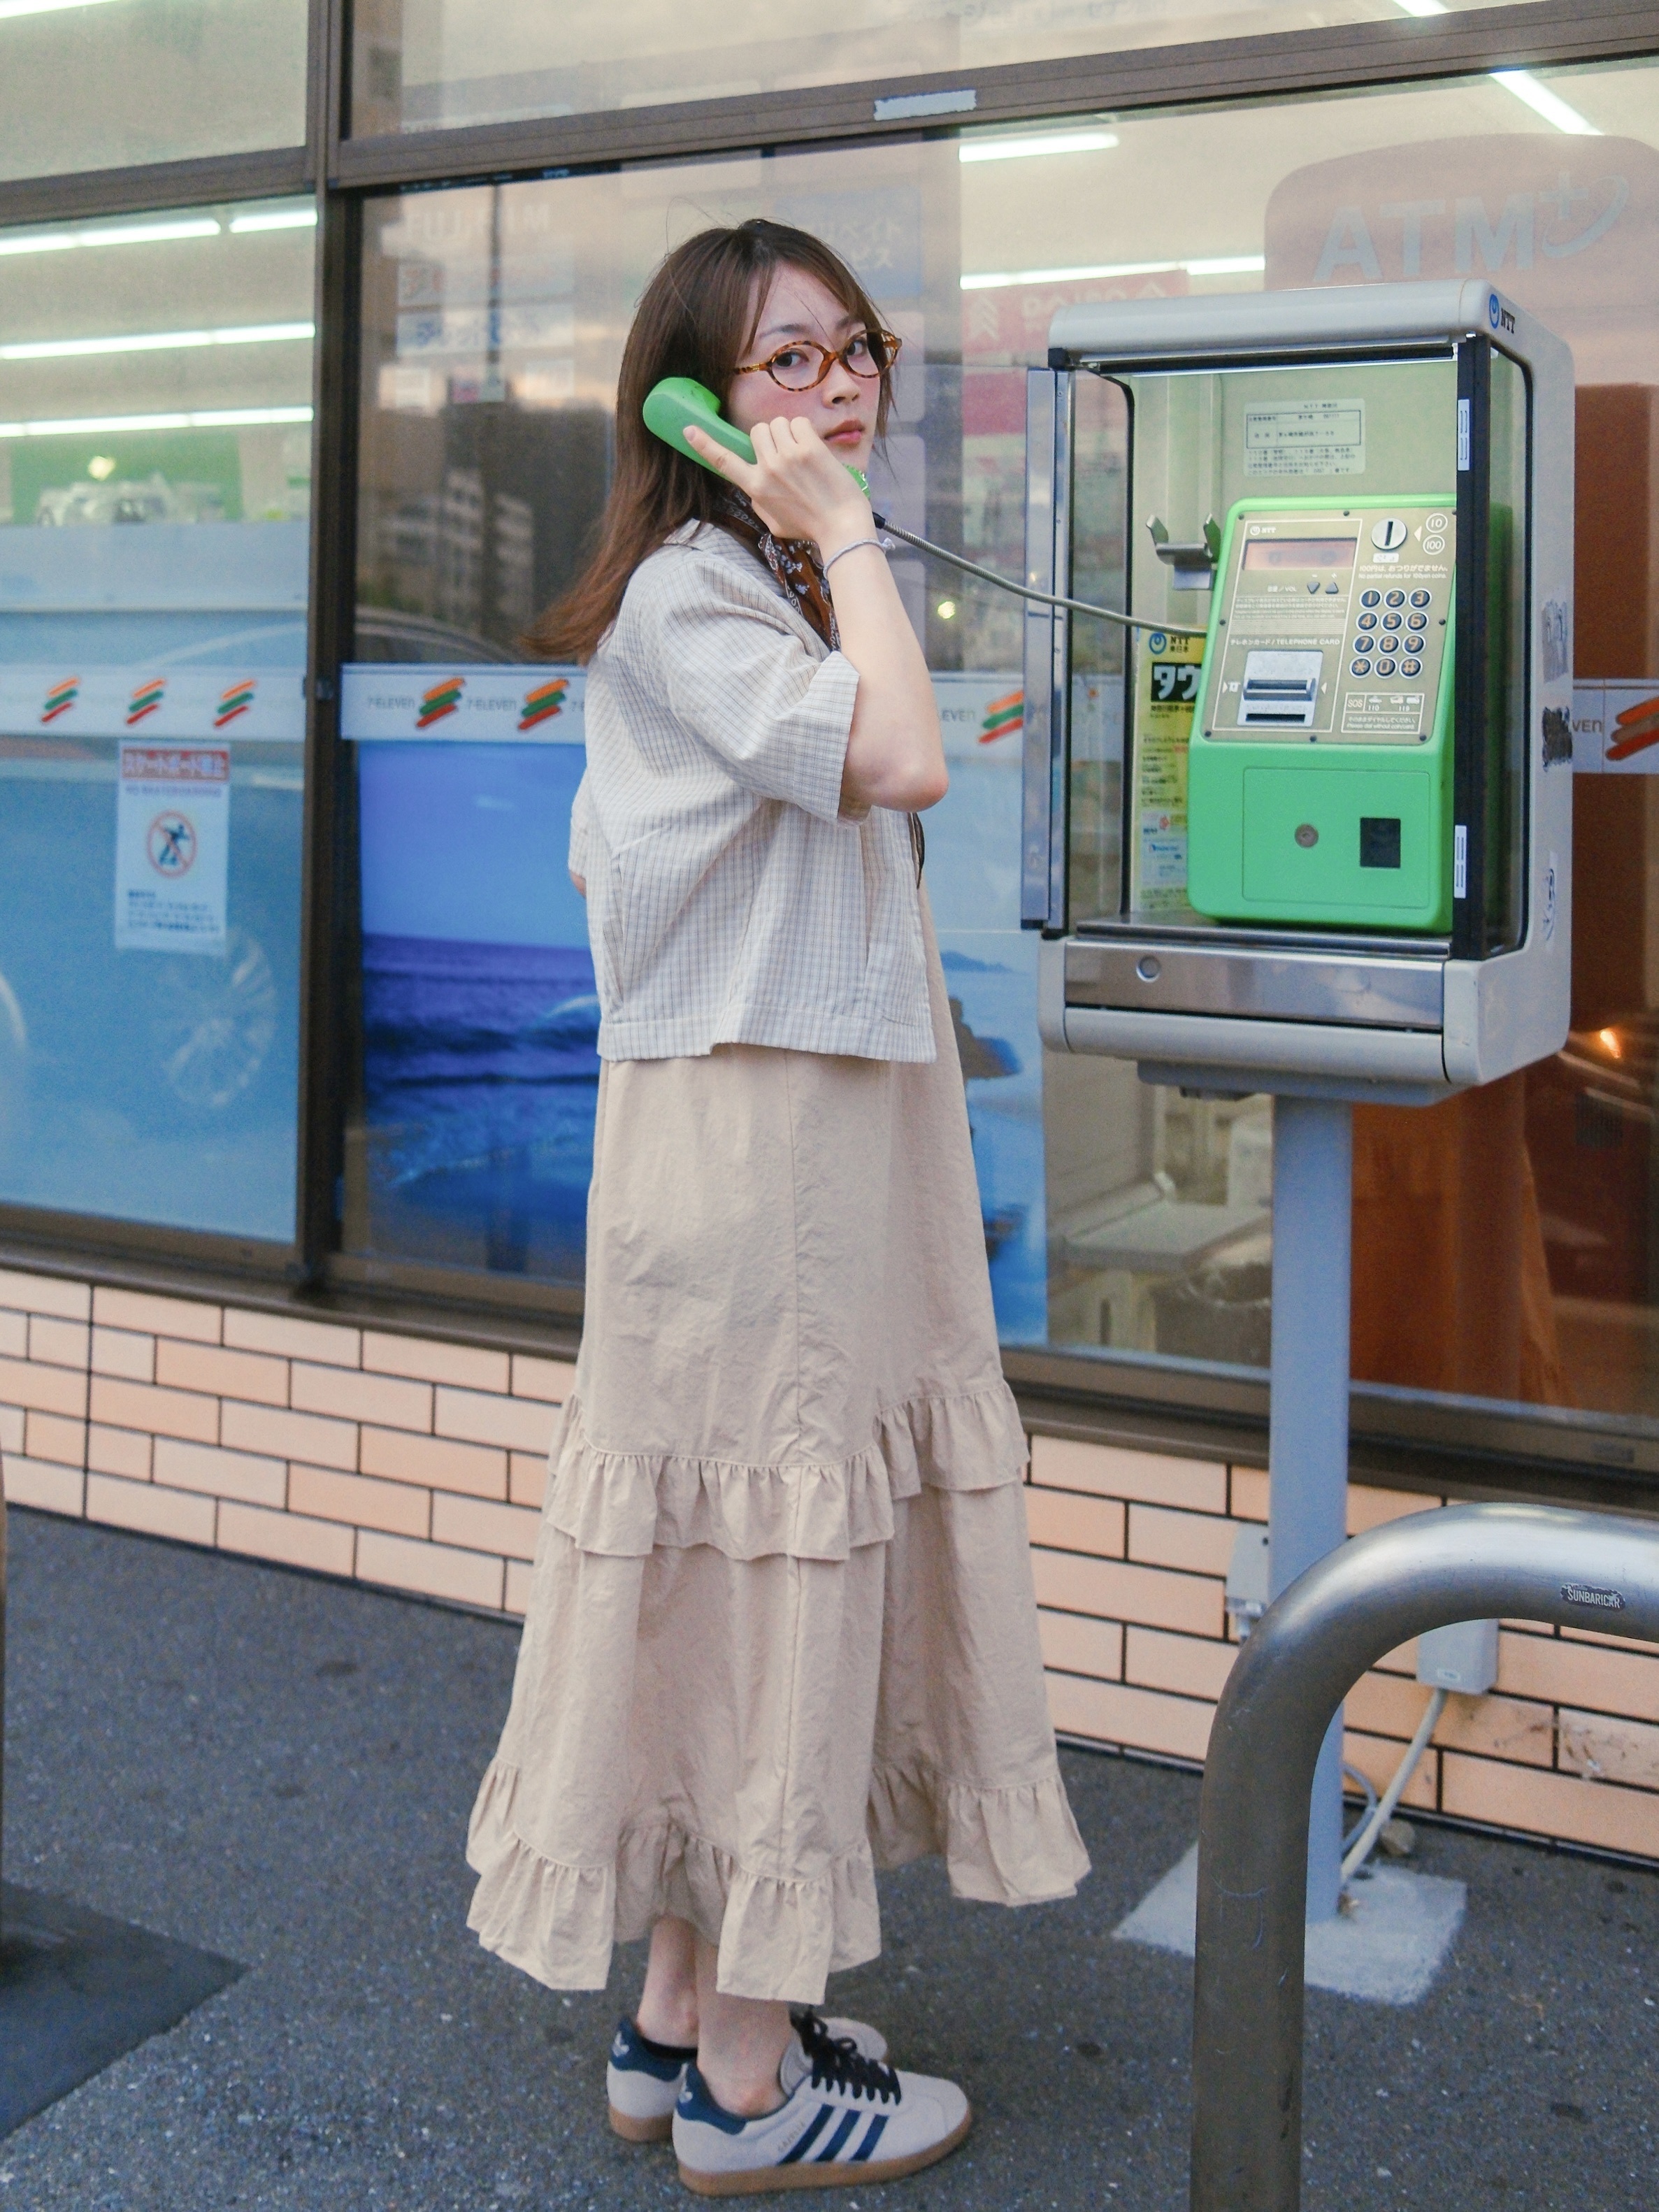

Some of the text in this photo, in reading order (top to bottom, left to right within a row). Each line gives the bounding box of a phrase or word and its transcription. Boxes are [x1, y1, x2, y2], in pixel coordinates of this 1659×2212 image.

[1500, 308, 1516, 334] NTT
[1431, 519, 1442, 528] 10
[1426, 541, 1442, 550] 100
[1367, 591, 1425, 605] 1 2 3
[1360, 615, 1422, 629] 4 5 6
[1170, 636, 1190, 645] NTT
[1358, 638, 1420, 651] 7 8 9
[1380, 660, 1391, 673] 0
[1153, 665, 1201, 701] タウ
[1347, 700, 1363, 708] SOS
[1567, 1588, 1621, 1609] SUNBARICAR
